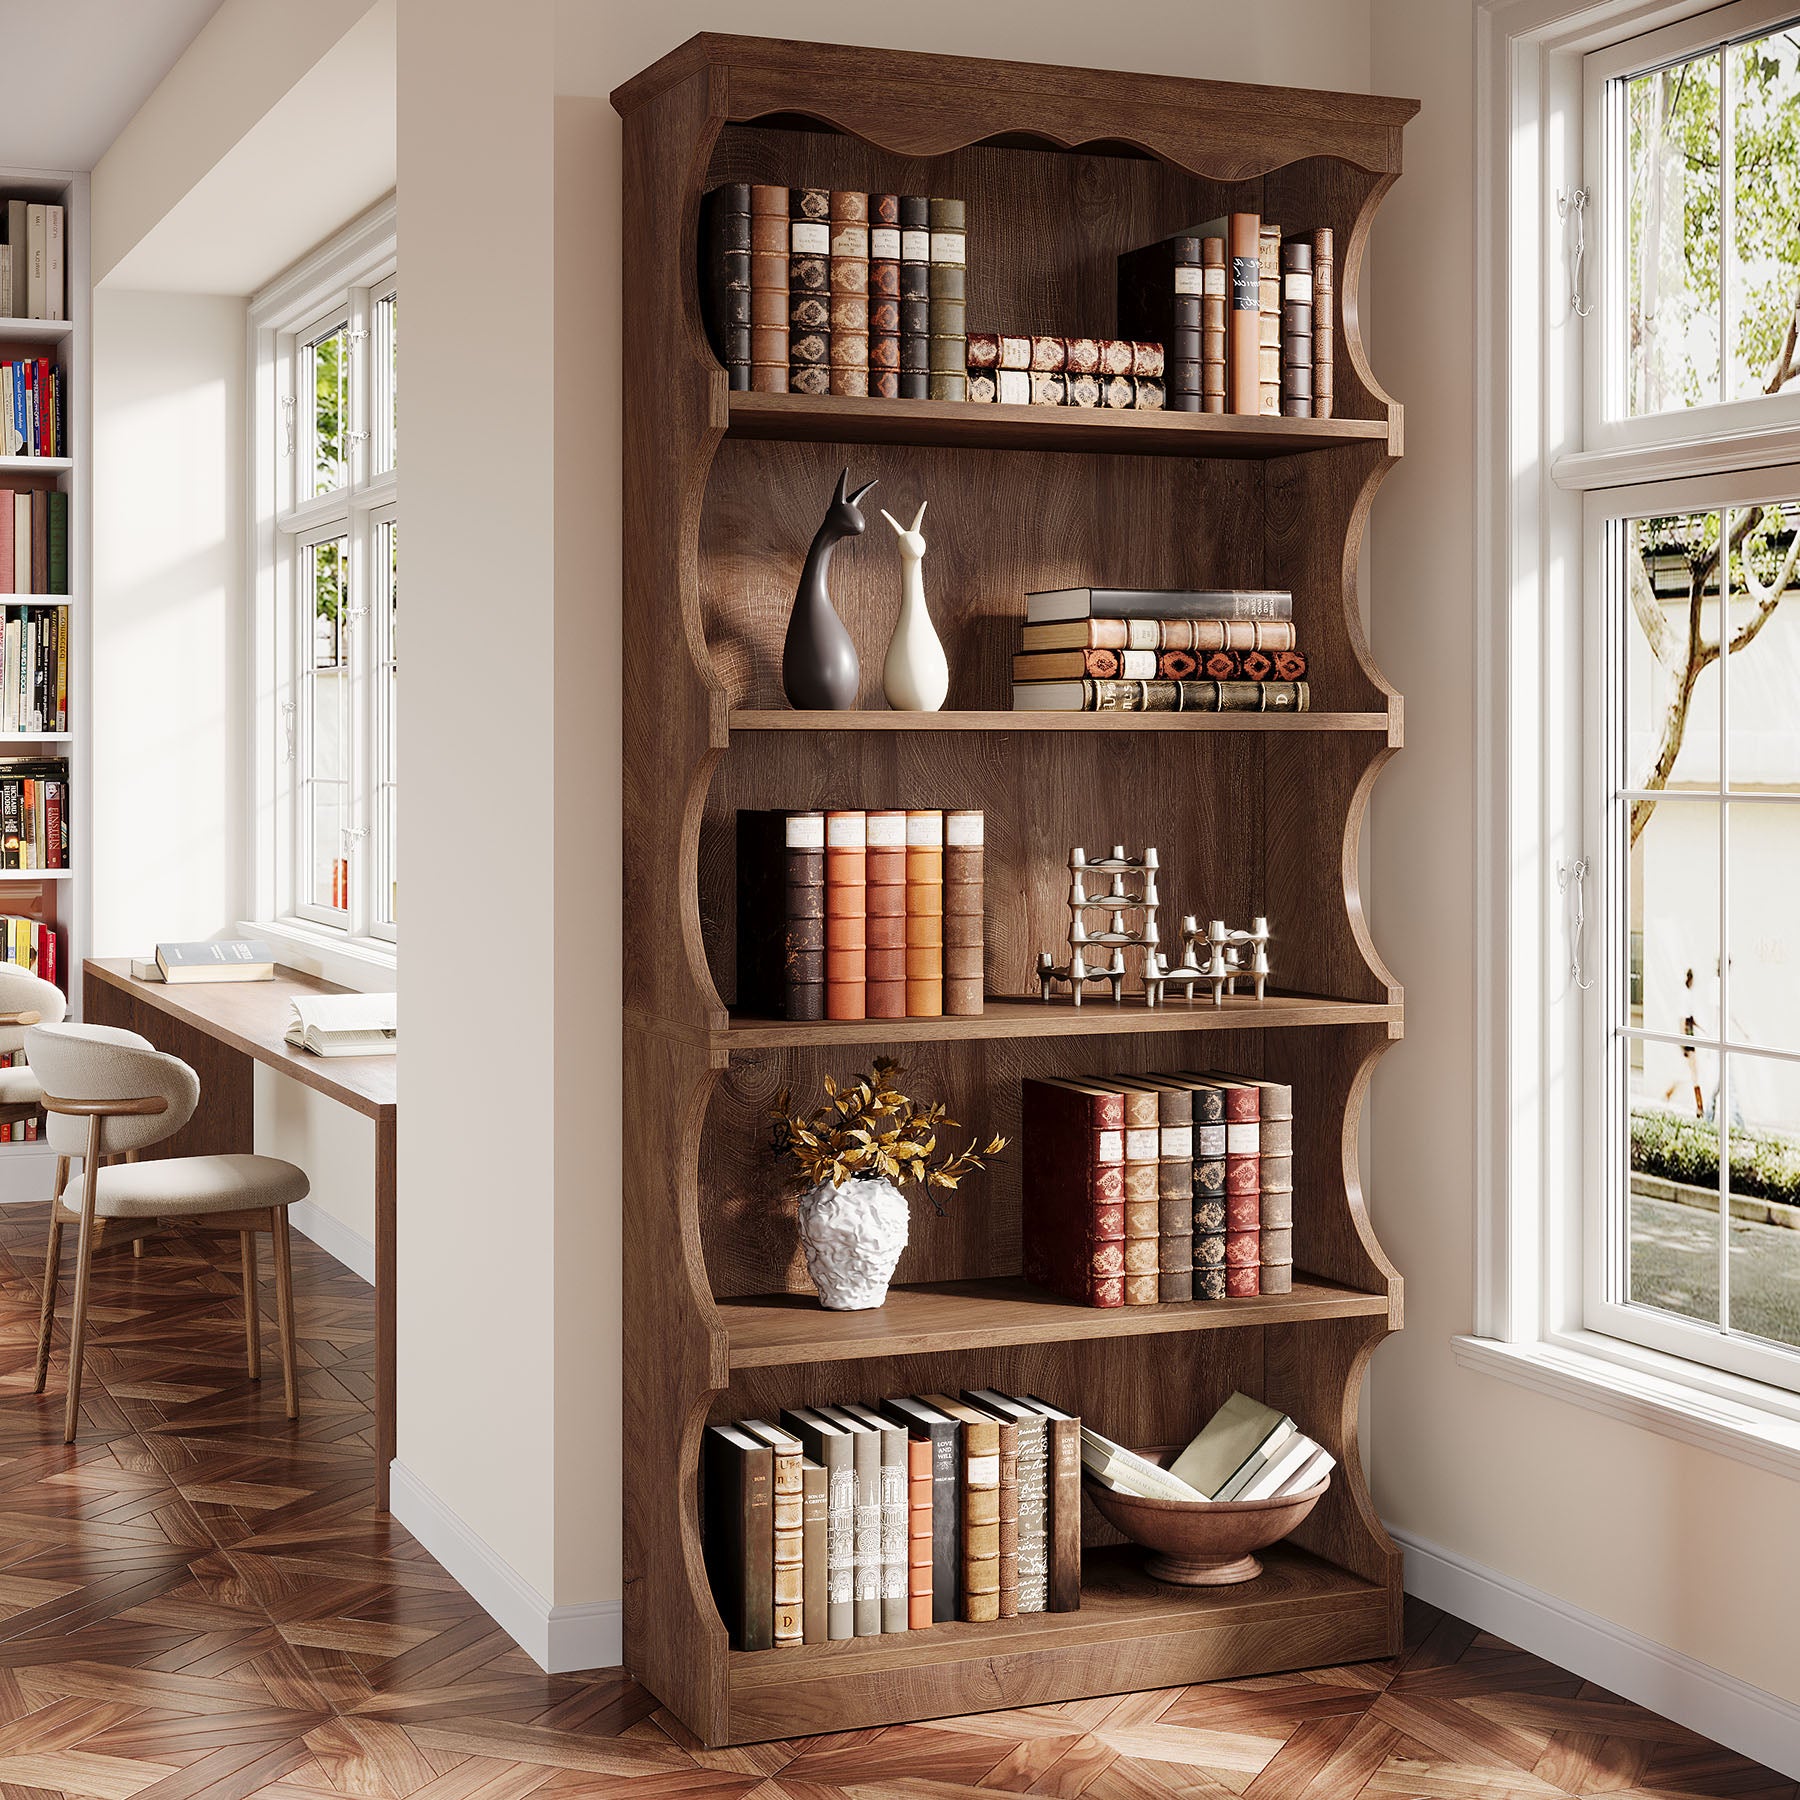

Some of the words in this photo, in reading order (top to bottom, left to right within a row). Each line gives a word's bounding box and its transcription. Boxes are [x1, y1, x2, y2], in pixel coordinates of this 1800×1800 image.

[1275, 693, 1288, 705] D
[52, 807, 60, 850] EINSTEIN
[783, 1616, 793, 1628] D
